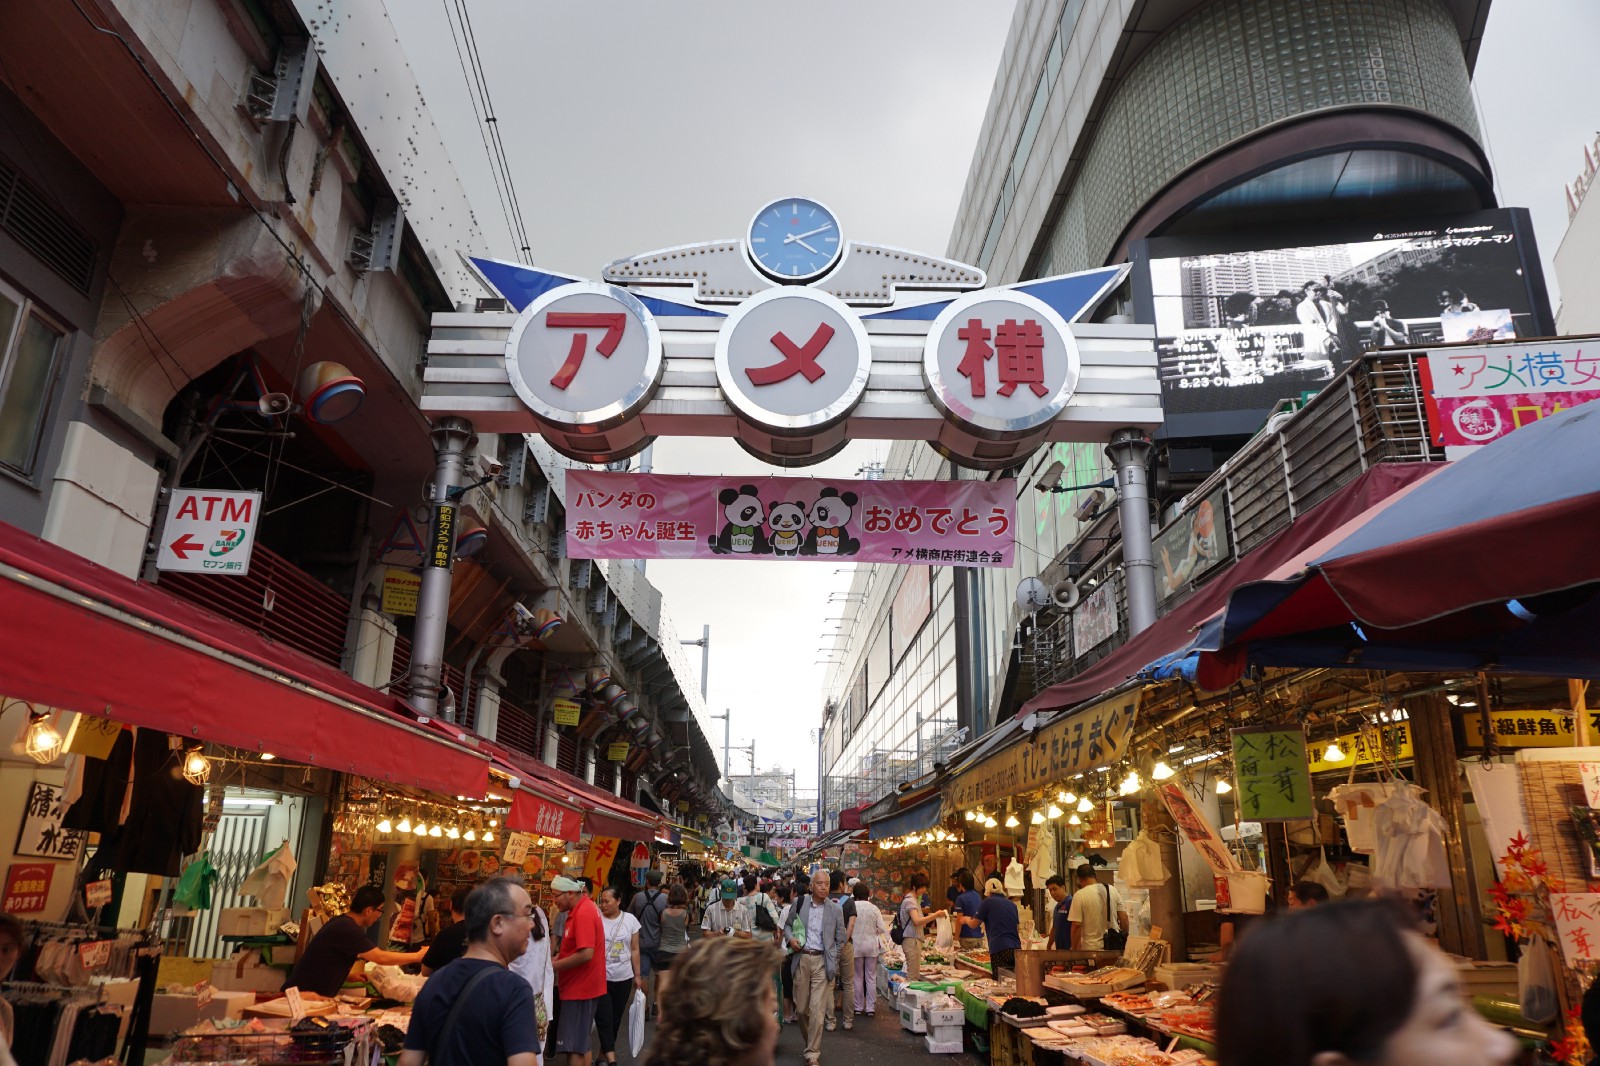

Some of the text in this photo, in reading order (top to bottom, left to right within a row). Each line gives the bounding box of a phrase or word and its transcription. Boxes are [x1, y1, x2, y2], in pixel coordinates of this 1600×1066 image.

[1212, 339, 1250, 350] Yro
[1253, 336, 1289, 349] Nda
[545, 311, 1049, 399] アメ横
[1179, 376, 1209, 388] 8.23
[176, 496, 253, 523] ATM
[575, 489, 656, 510] パンダの
[575, 520, 696, 541] 赤ちゃん誕生
[864, 505, 1010, 536] おめでとう
[434, 505, 453, 567] 防犯カメラ作動中
[731, 538, 754, 547] UENO
[816, 539, 840, 548] UENO
[203, 560, 243, 570] セブン銀行
[891, 548, 1004, 563] アメ横商店街連合会
[1237, 734, 1262, 816] 入荷です
[767, 824, 808, 832] アメ横
[36, 823, 83, 857] 水産
